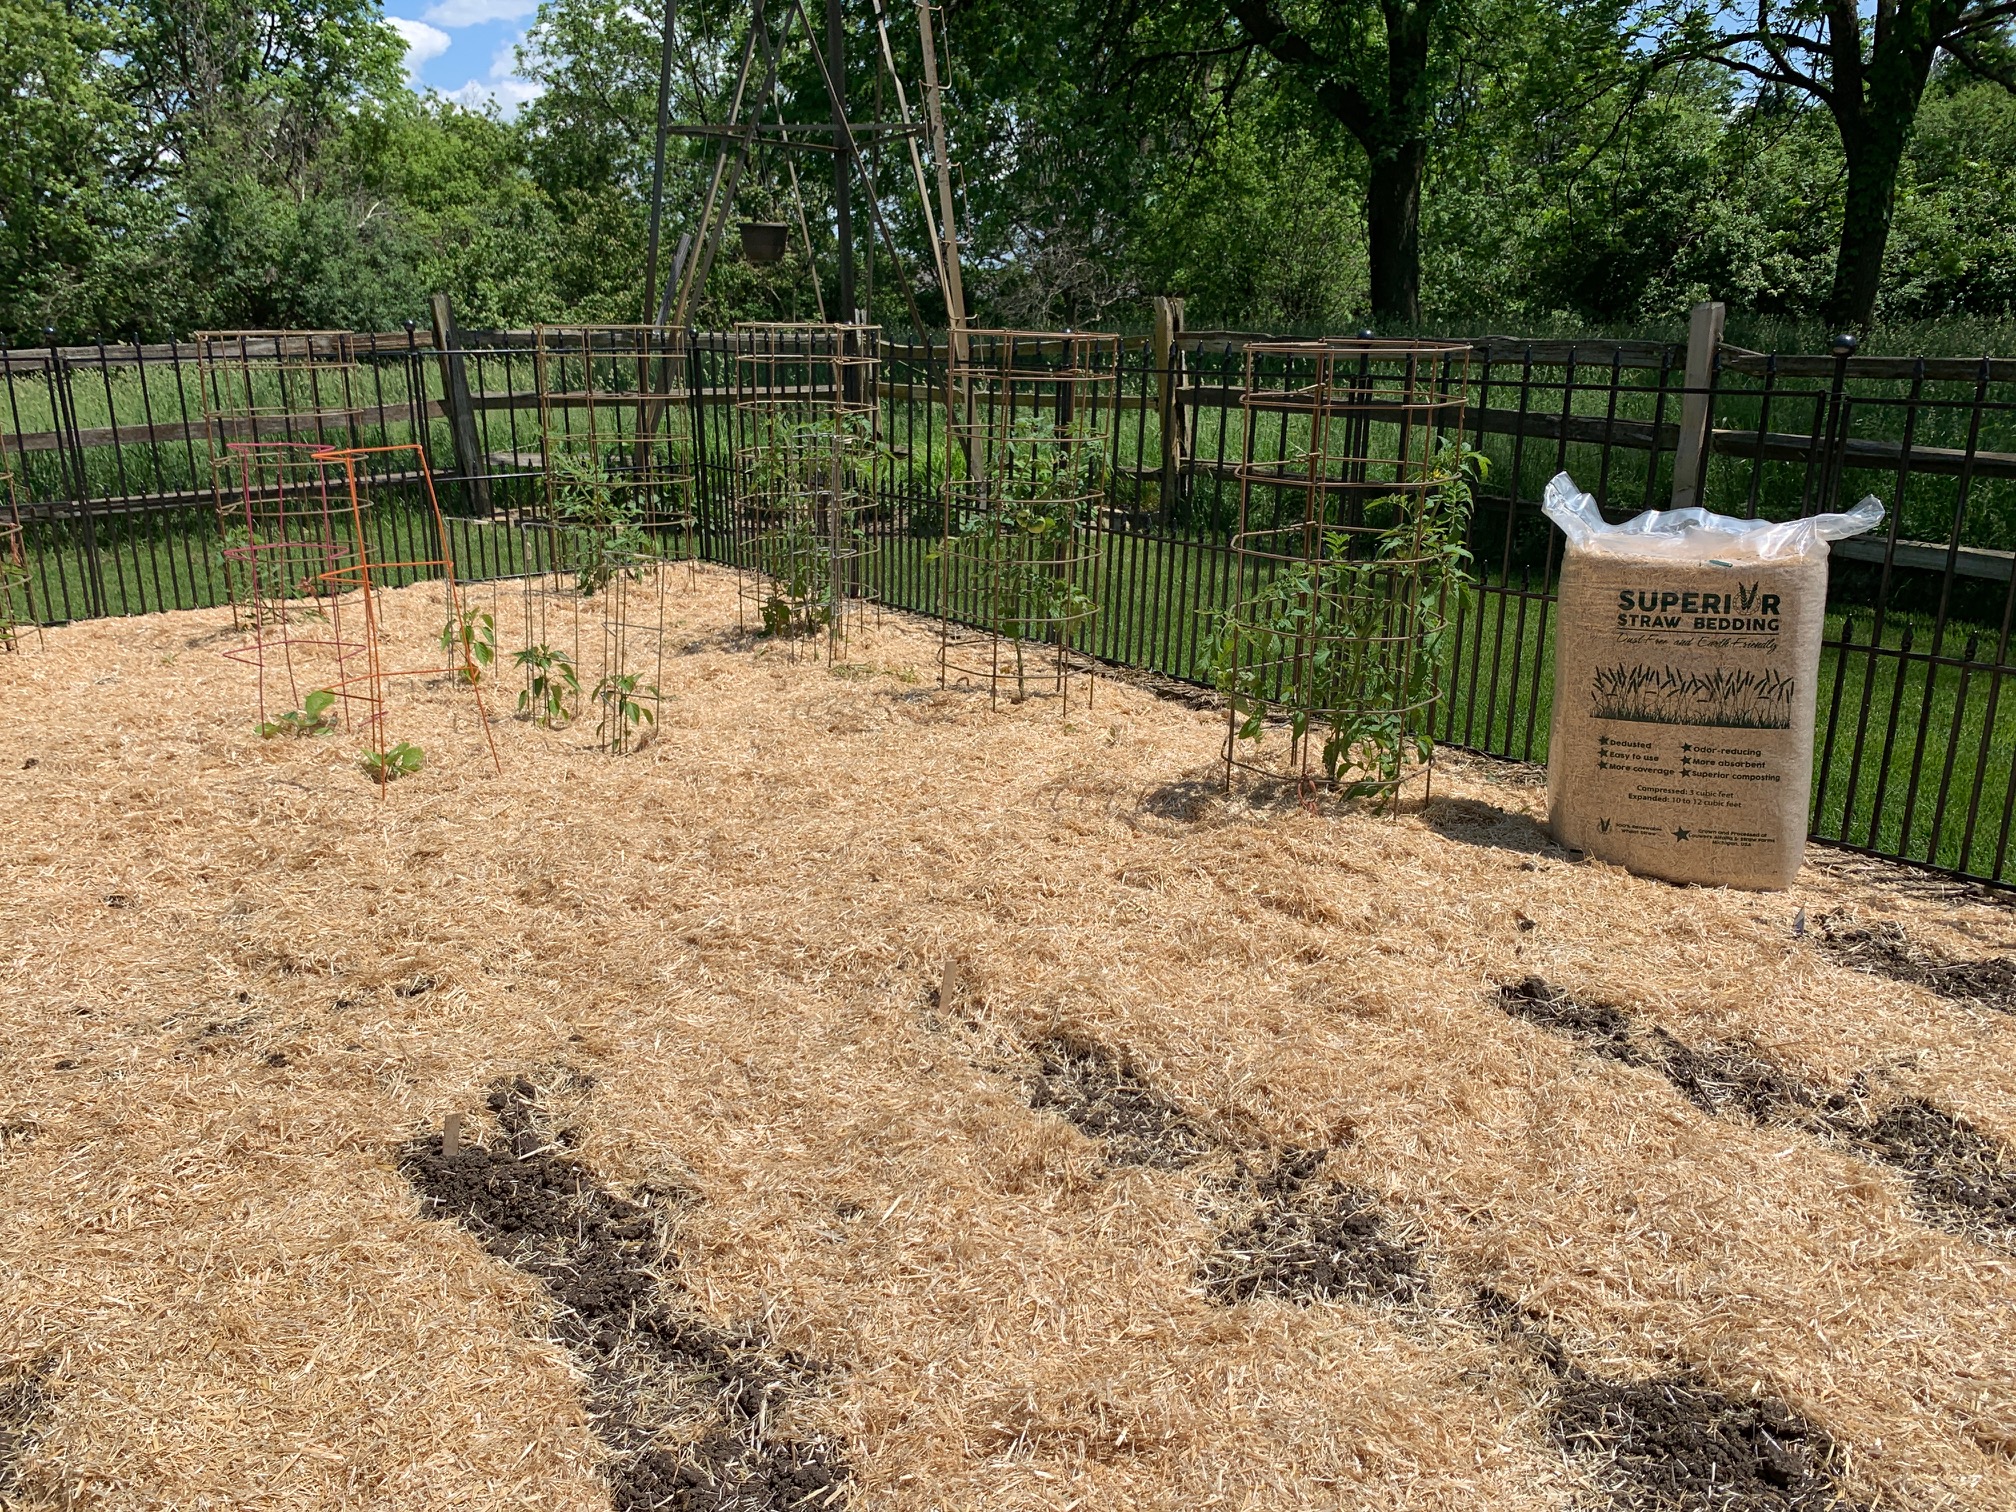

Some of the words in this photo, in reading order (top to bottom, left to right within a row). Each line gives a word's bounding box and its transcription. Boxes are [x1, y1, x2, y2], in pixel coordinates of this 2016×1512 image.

[1618, 581, 1781, 615] SUPERIOR
[1618, 613, 1681, 629] STRAW
[1694, 617, 1779, 632] BEDDING
[1674, 637, 1695, 646] and
[1610, 740, 1652, 749] Dedusted
[1609, 752, 1630, 760] Easy
[1693, 746, 1762, 757] Odor-reducing
[1692, 758, 1716, 766] More
[1718, 760, 1766, 768] absorbent
[1633, 766, 1675, 776] coverage
[1692, 770, 1730, 779] Superior
[1732, 773, 1781, 782] composting
[1636, 785, 1688, 795] Compressed:
[1628, 793, 1670, 802] Expanded:
[1703, 799, 1724, 807] cubic
